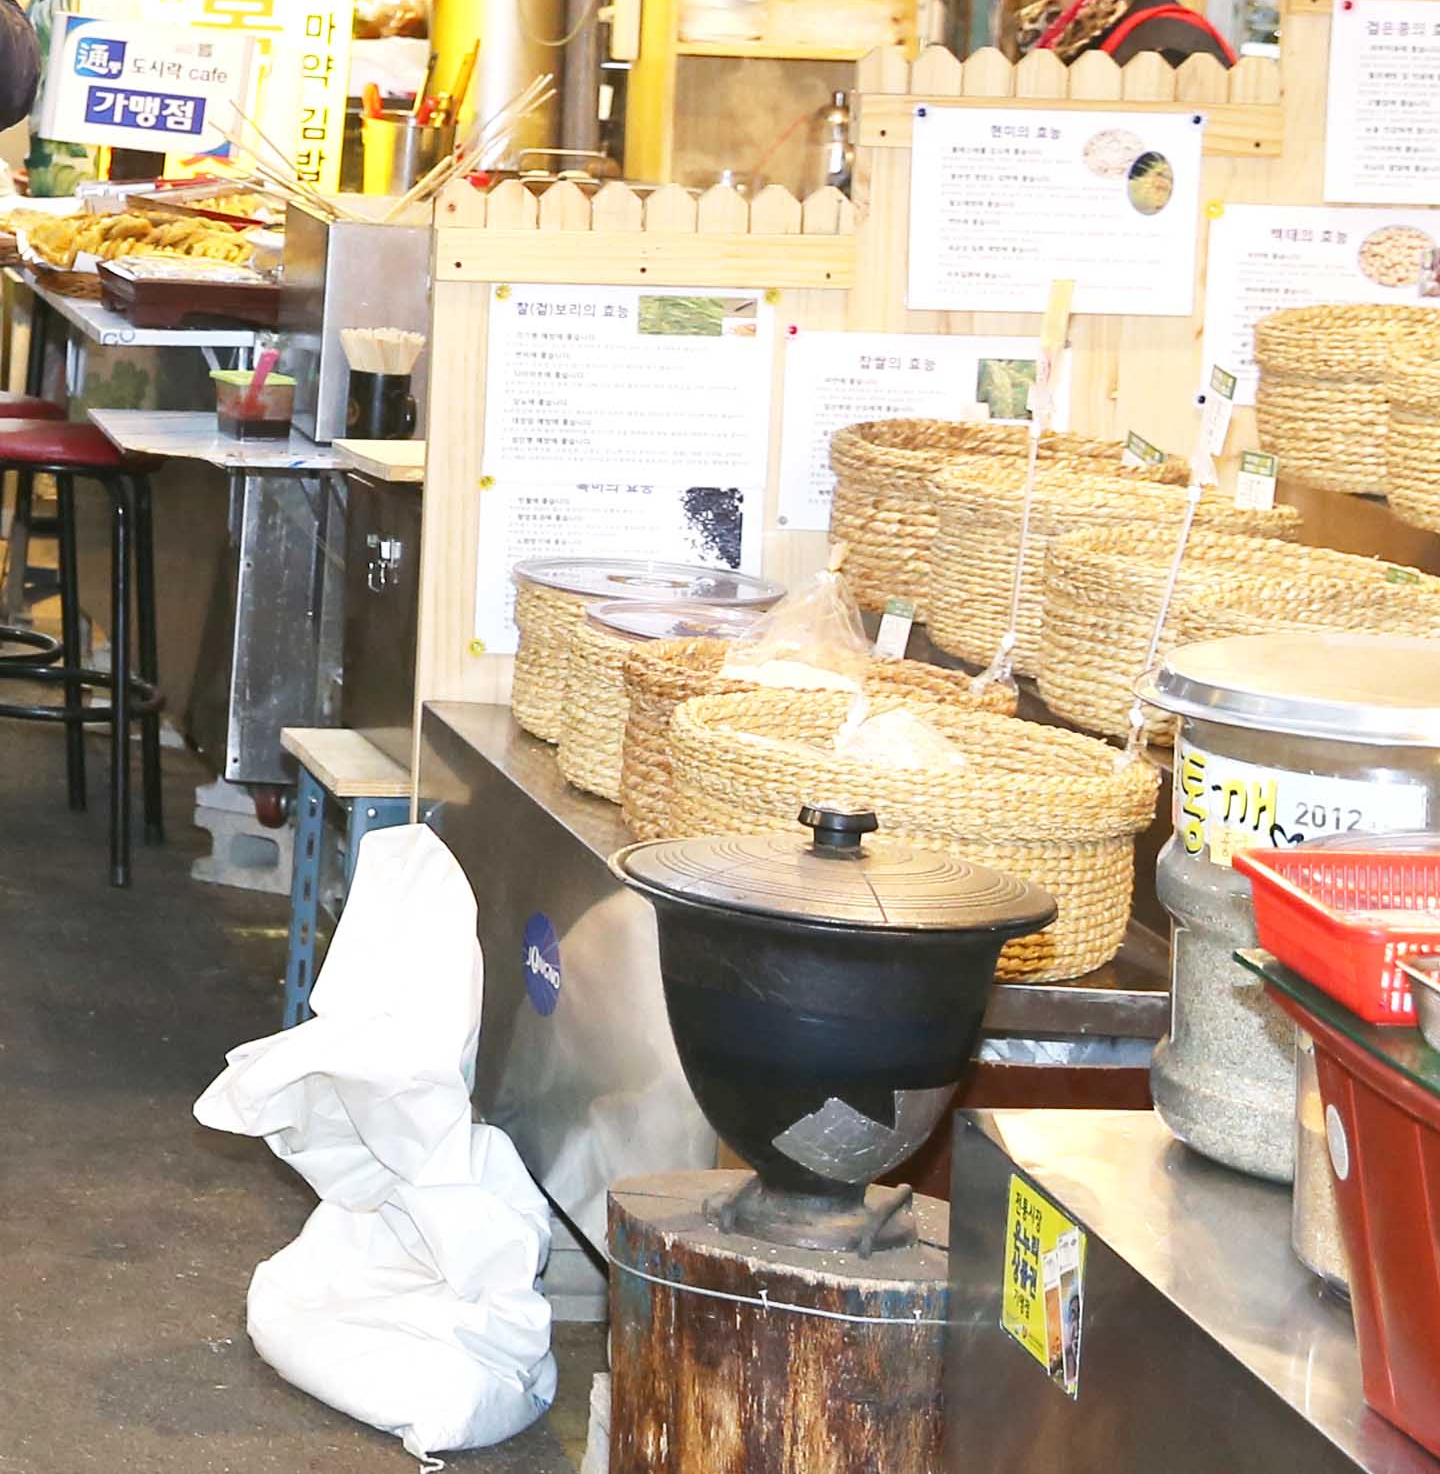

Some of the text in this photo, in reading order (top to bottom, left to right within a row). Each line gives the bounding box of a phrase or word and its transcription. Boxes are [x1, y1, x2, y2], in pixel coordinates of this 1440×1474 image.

[132, 56, 228, 84] 도시락 cafe
[92, 91, 196, 132] 가맹점
